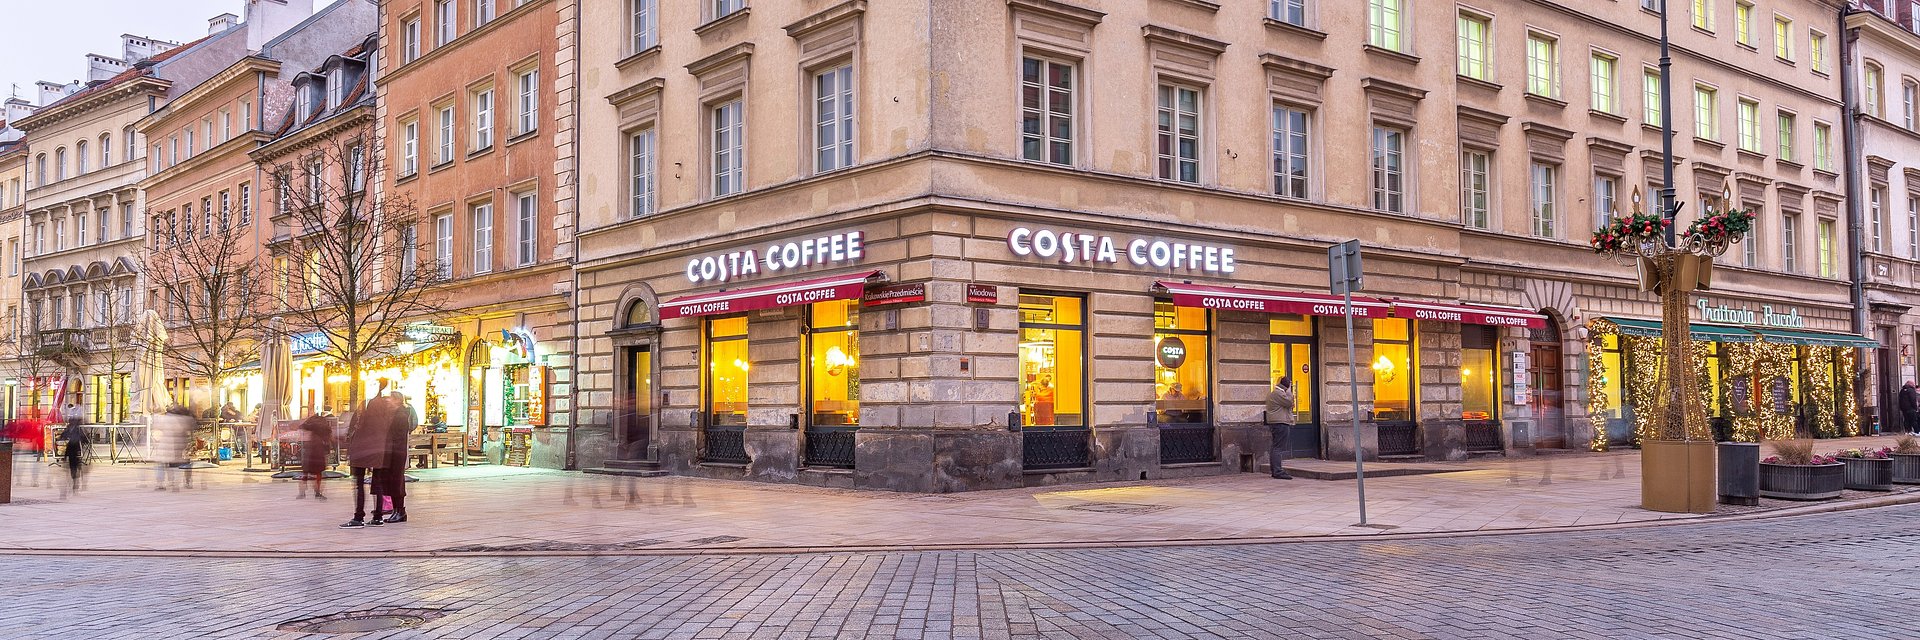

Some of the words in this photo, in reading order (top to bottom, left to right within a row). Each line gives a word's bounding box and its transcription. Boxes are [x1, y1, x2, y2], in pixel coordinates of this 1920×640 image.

[1007, 226, 1117, 264] COSTA
[1126, 238, 1235, 273] COFFEE
[686, 249, 758, 283] COSTA
[765, 230, 865, 272] COFFEE
[776, 292, 802, 306] COSTA
[804, 288, 836, 302] COFFEE
[969, 288, 997, 298] Miodowa
[680, 305, 702, 316] COSTA
[703, 301, 729, 313] COFFEE
[1202, 297, 1232, 309] COSTA
[1233, 299, 1265, 310] COFFEE
[1313, 304, 1339, 315] COSTA
[1339, 307, 1368, 316] CFFEE
[1415, 309, 1437, 320] COSTA
[1438, 311, 1462, 321] COFFEE
[1697, 298, 1756, 324] Trattoria
[1762, 305, 1804, 328] Rucola
[1485, 315, 1506, 325] COSTA
[1506, 317, 1528, 326] COFFEE
[1162, 346, 1184, 355] COSTA
